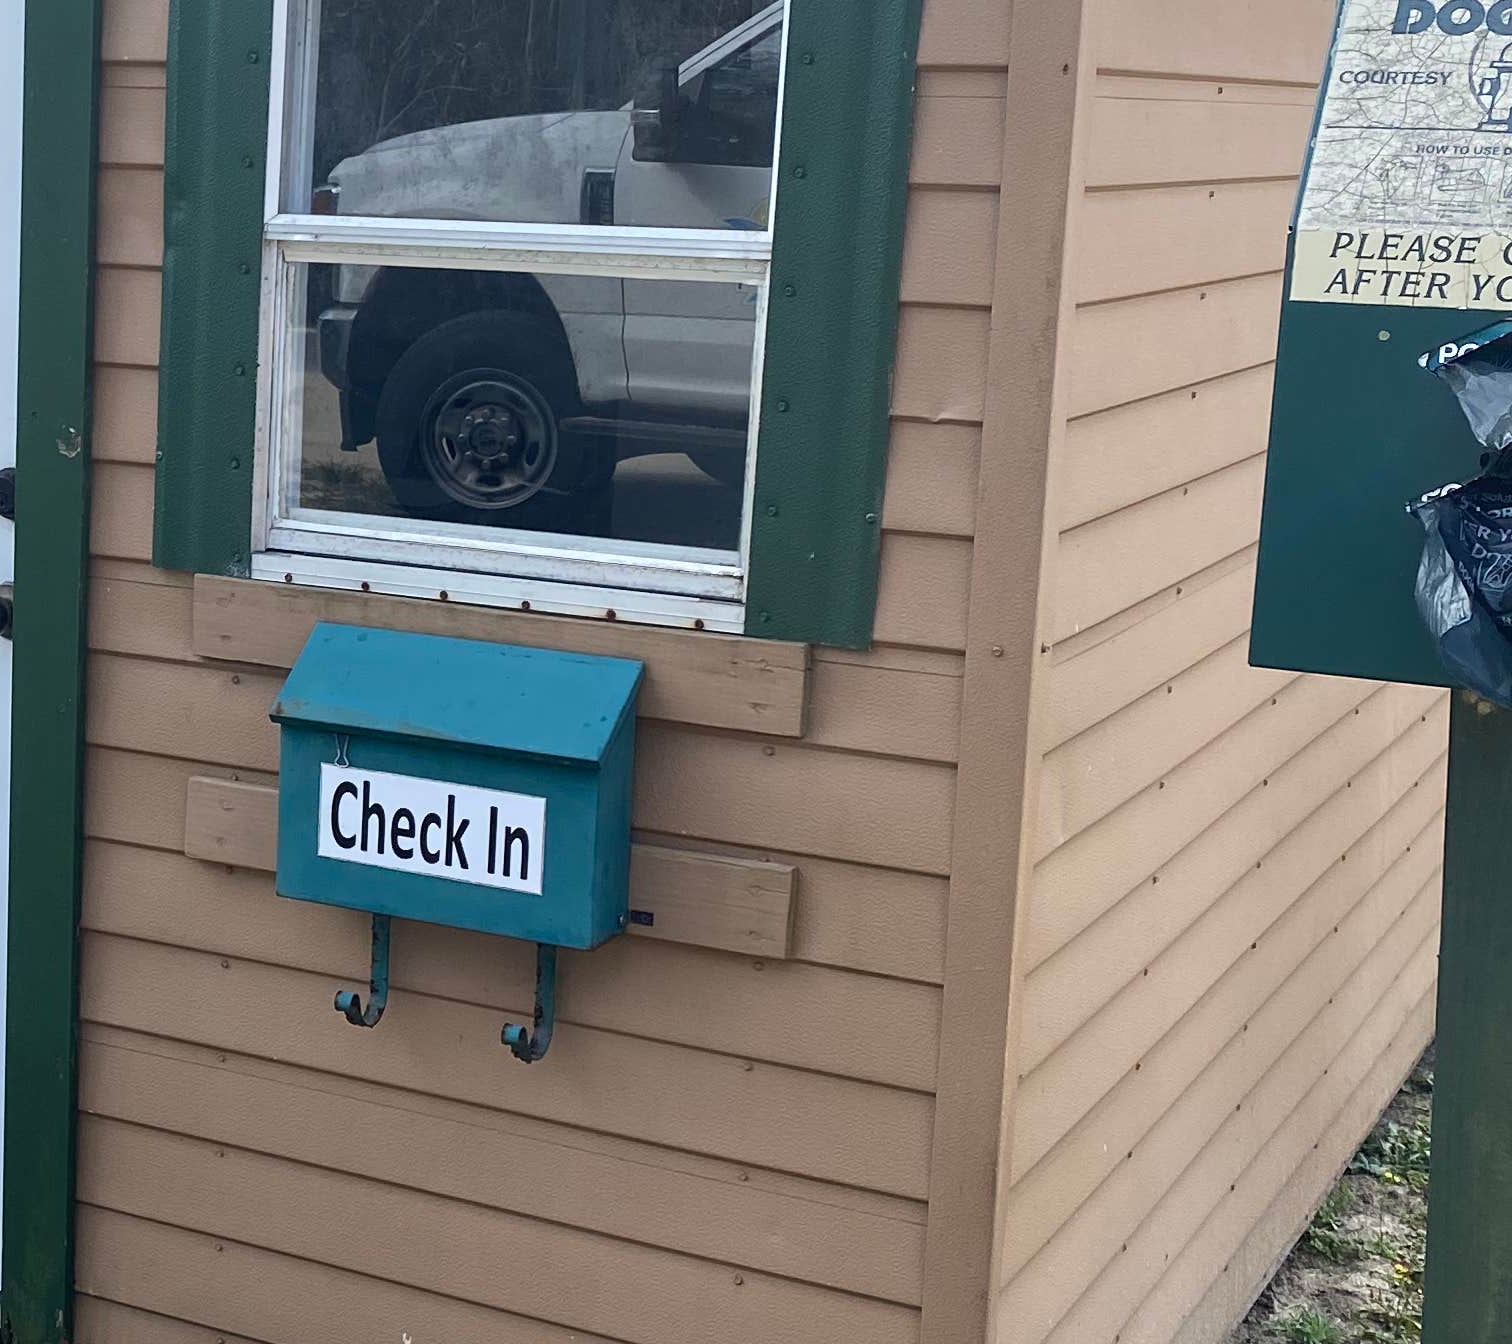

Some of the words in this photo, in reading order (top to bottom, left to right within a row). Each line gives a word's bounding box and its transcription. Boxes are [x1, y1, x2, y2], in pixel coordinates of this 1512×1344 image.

[1340, 70, 1455, 86] COURTESY
[1416, 144, 1448, 154] HOW
[1454, 145, 1469, 154] TO
[1474, 146, 1501, 155] USE
[1329, 231, 1481, 264] PLEASE
[1324, 268, 1451, 299] AFTER
[330, 780, 471, 869] Check
[488, 805, 530, 880] In
